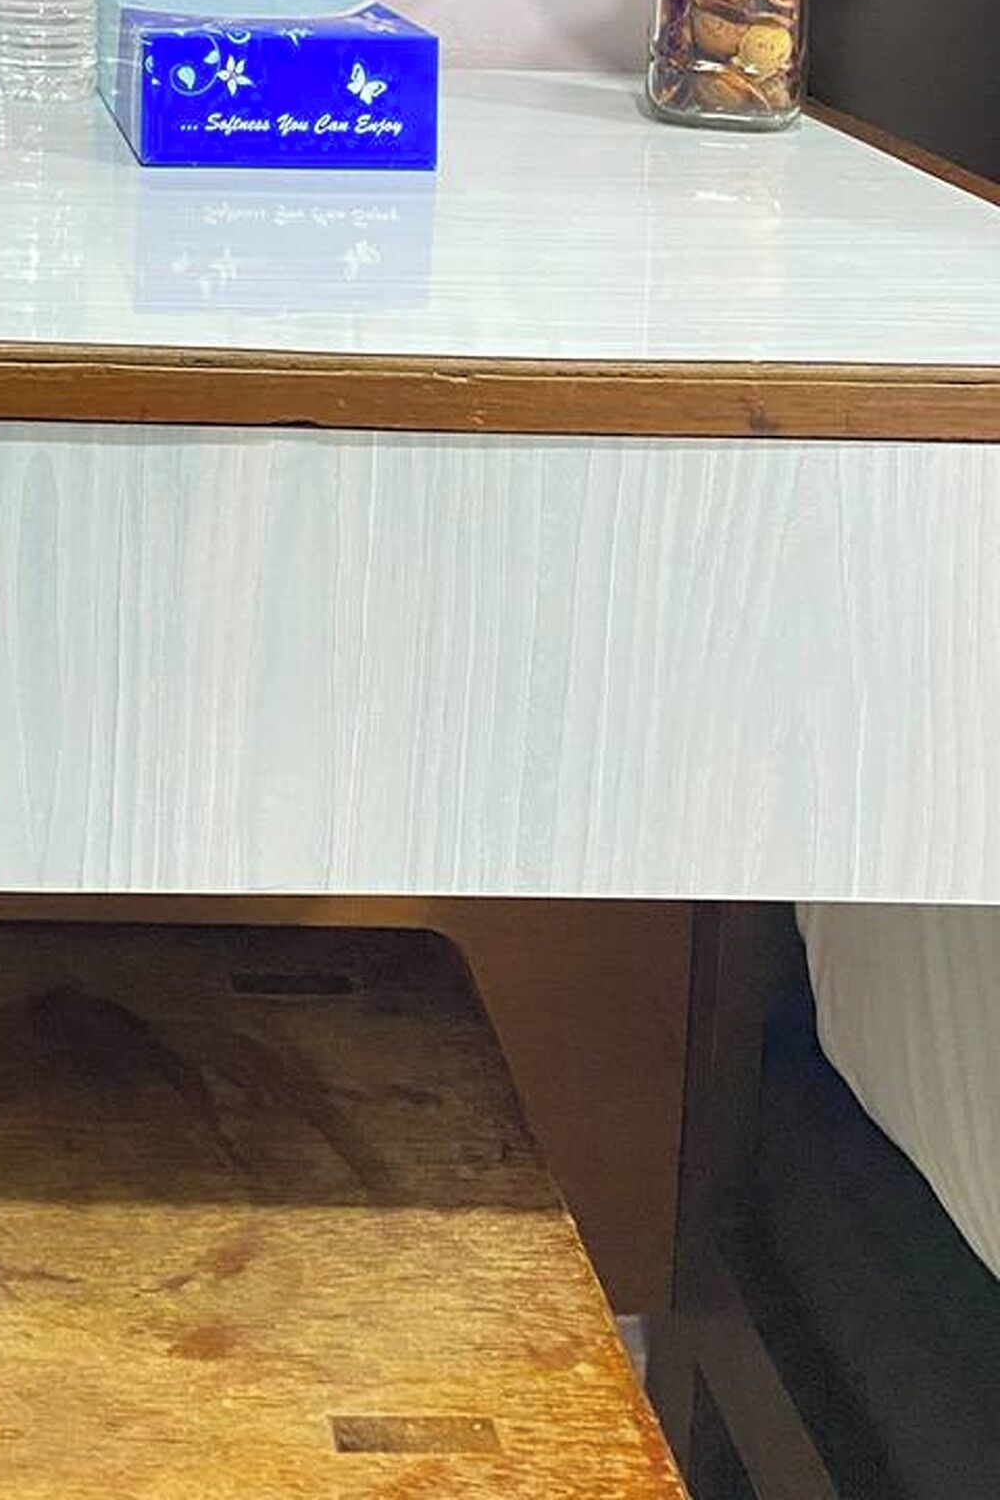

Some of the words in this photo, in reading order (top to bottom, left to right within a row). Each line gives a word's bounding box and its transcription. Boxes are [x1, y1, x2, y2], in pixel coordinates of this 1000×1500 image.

[204, 112, 270, 137] Softness
[276, 112, 309, 137] You
[313, 113, 349, 136] Can
[353, 113, 404, 137] Enjoy
